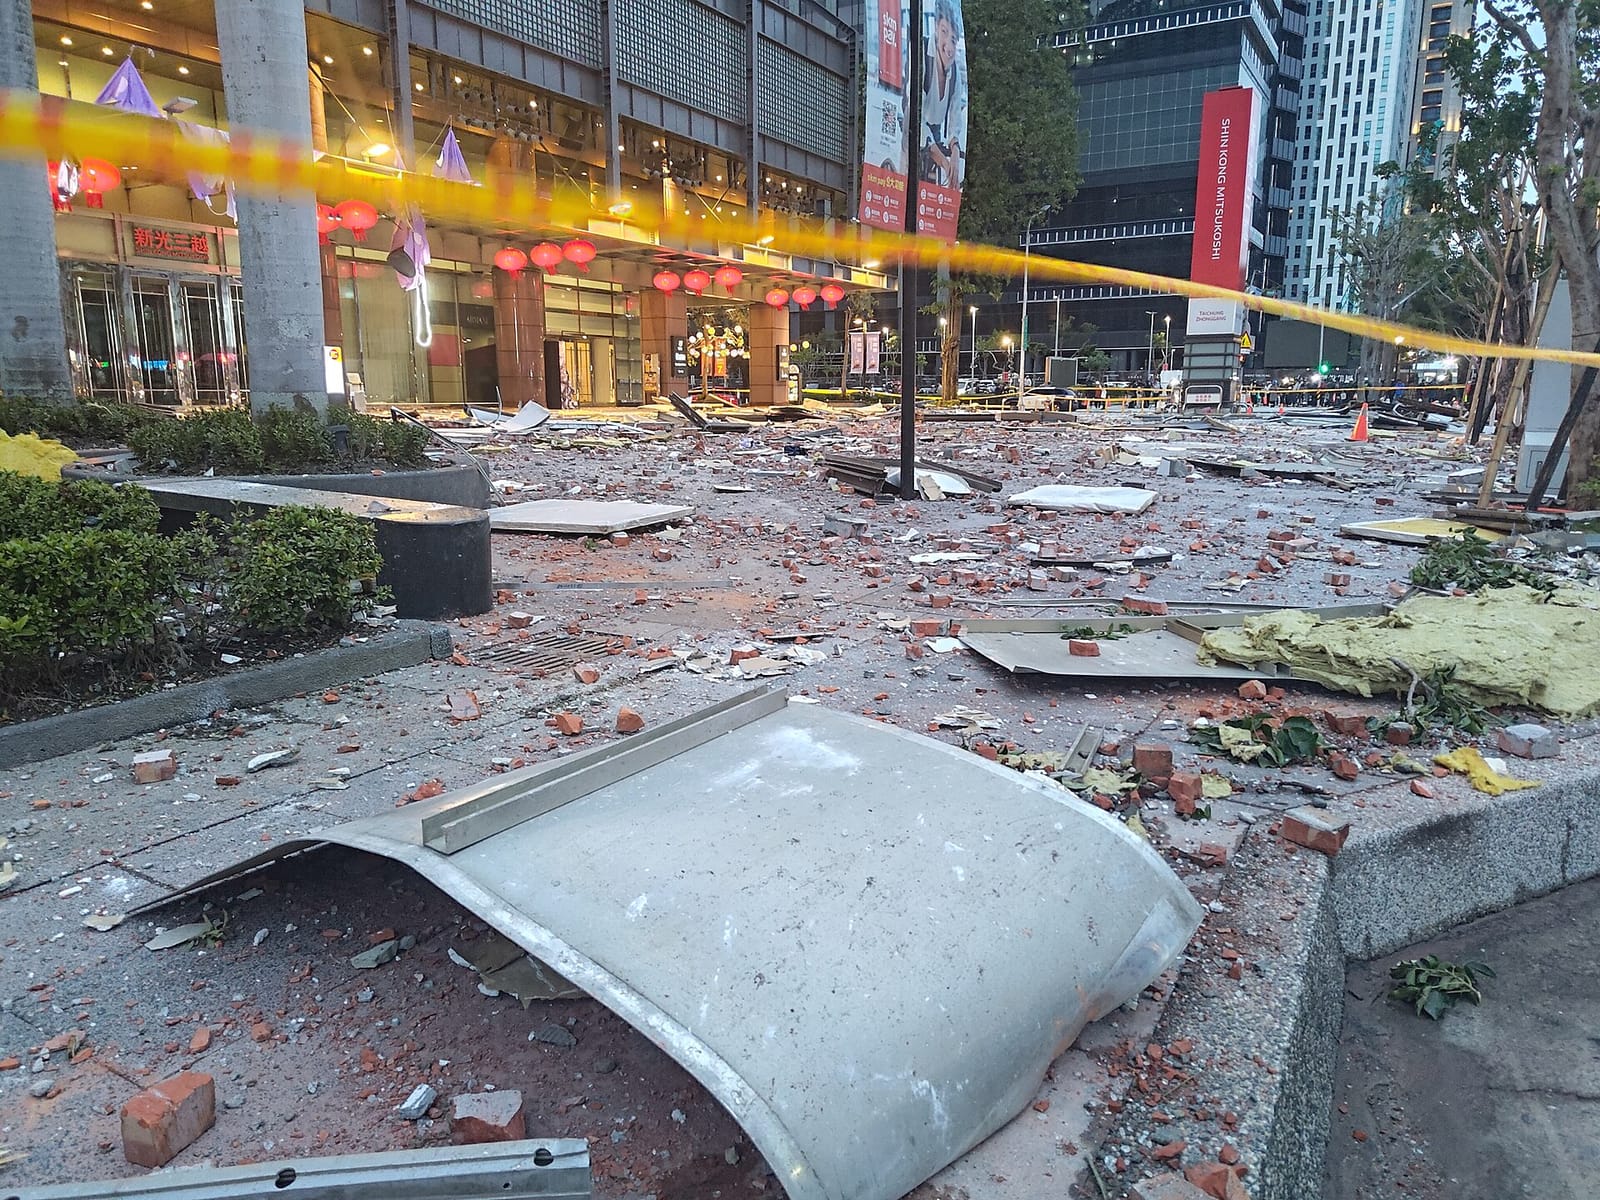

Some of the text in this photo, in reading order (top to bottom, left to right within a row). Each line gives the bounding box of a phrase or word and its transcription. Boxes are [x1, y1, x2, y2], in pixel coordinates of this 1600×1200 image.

[883, 11, 897, 32] skm
[1211, 118, 1231, 260] SHIN KONG MITSUKOSHI
[134, 227, 209, 255] 新光三越
